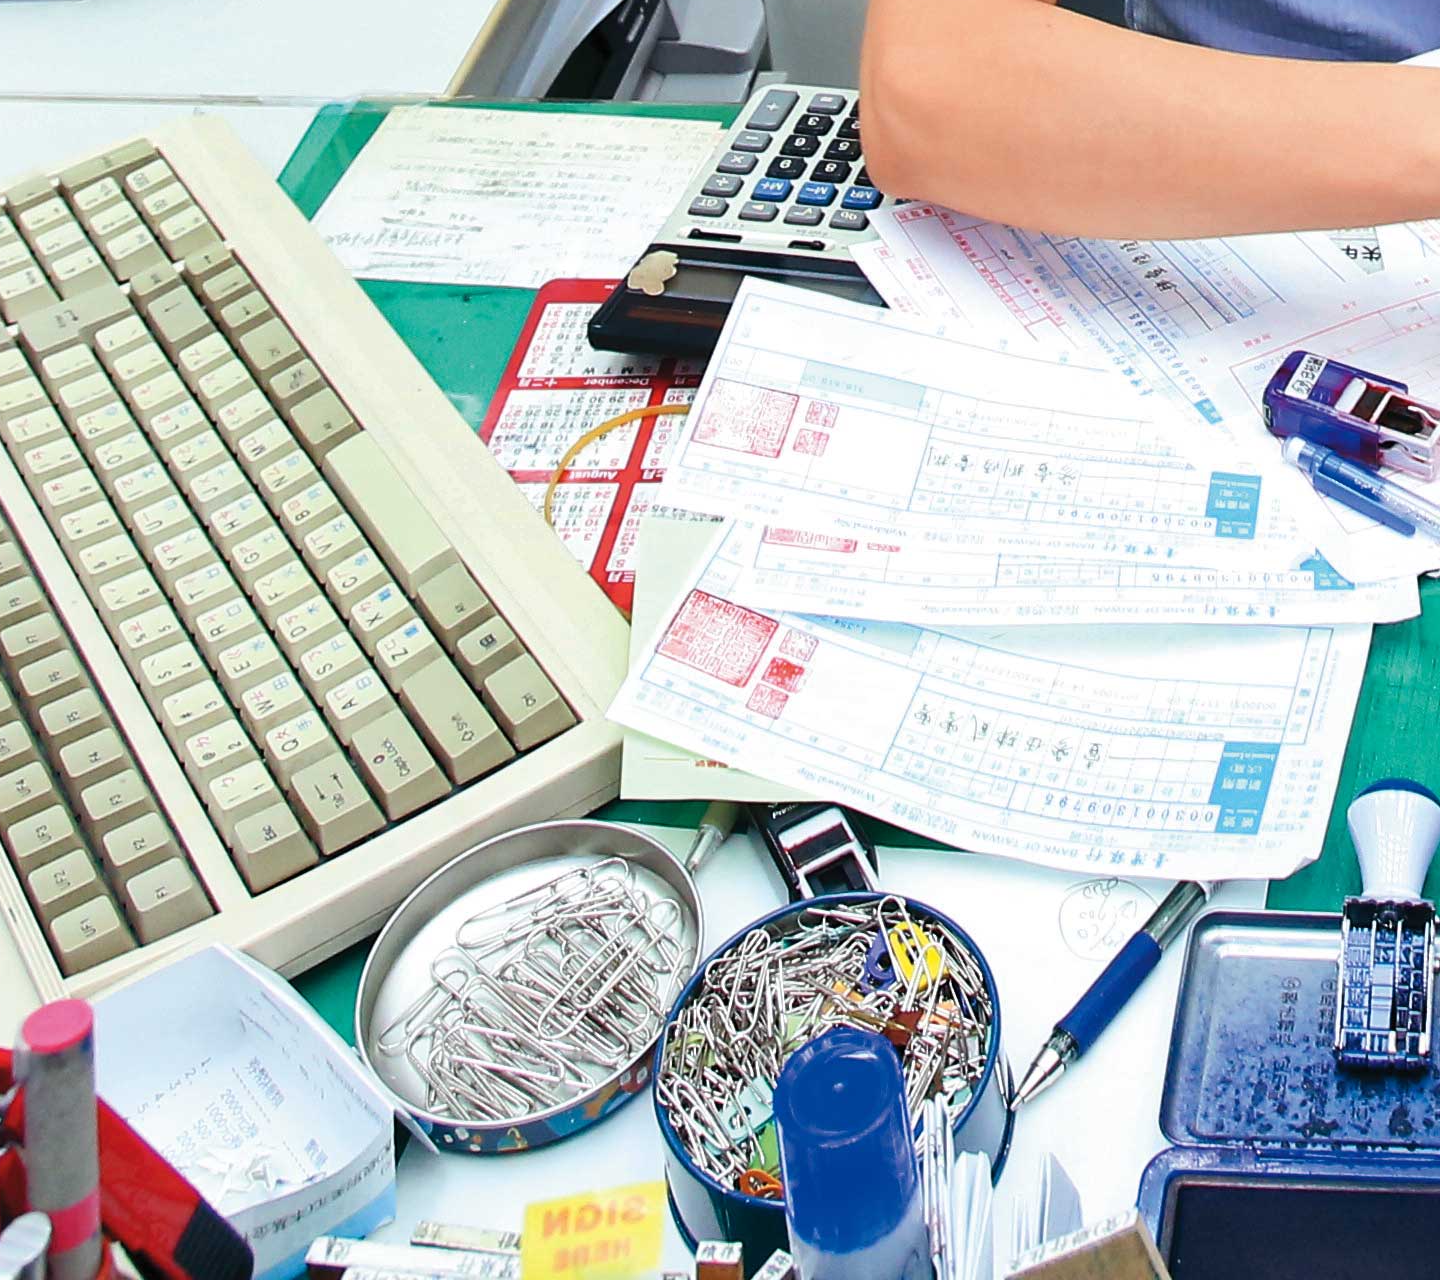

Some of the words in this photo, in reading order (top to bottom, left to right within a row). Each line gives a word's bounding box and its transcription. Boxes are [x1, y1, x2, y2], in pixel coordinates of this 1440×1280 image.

[806, 115, 819, 127] 3
[794, 135, 806, 147] 6
[778, 158, 791, 170] 9
[824, 160, 837, 173] 8
[848, 189, 872, 202] MR
[697, 197, 717, 209] GT
[517, 376, 557, 387] 十二月
[583, 376, 649, 386] December
[569, 394, 585, 403] 31
[588, 394, 605, 403] 30
[608, 394, 624, 403] 29
[628, 394, 645, 403] 28
[667, 393, 684, 402] 30
[569, 469, 617, 480] August
[607, 570, 635, 583] 三月
[522, 695, 537, 707] Ctrl
[451, 716, 468, 732] Shift
[382, 738, 398, 758] Lock
[394, 756, 410, 777] Caps
[333, 793, 344, 809] Tab
[262, 825, 277, 841] Esc
[969, 829, 1022, 848] TAIWAN
[1022, 837, 1041, 853] OF
[1041, 840, 1078, 859] BANK
